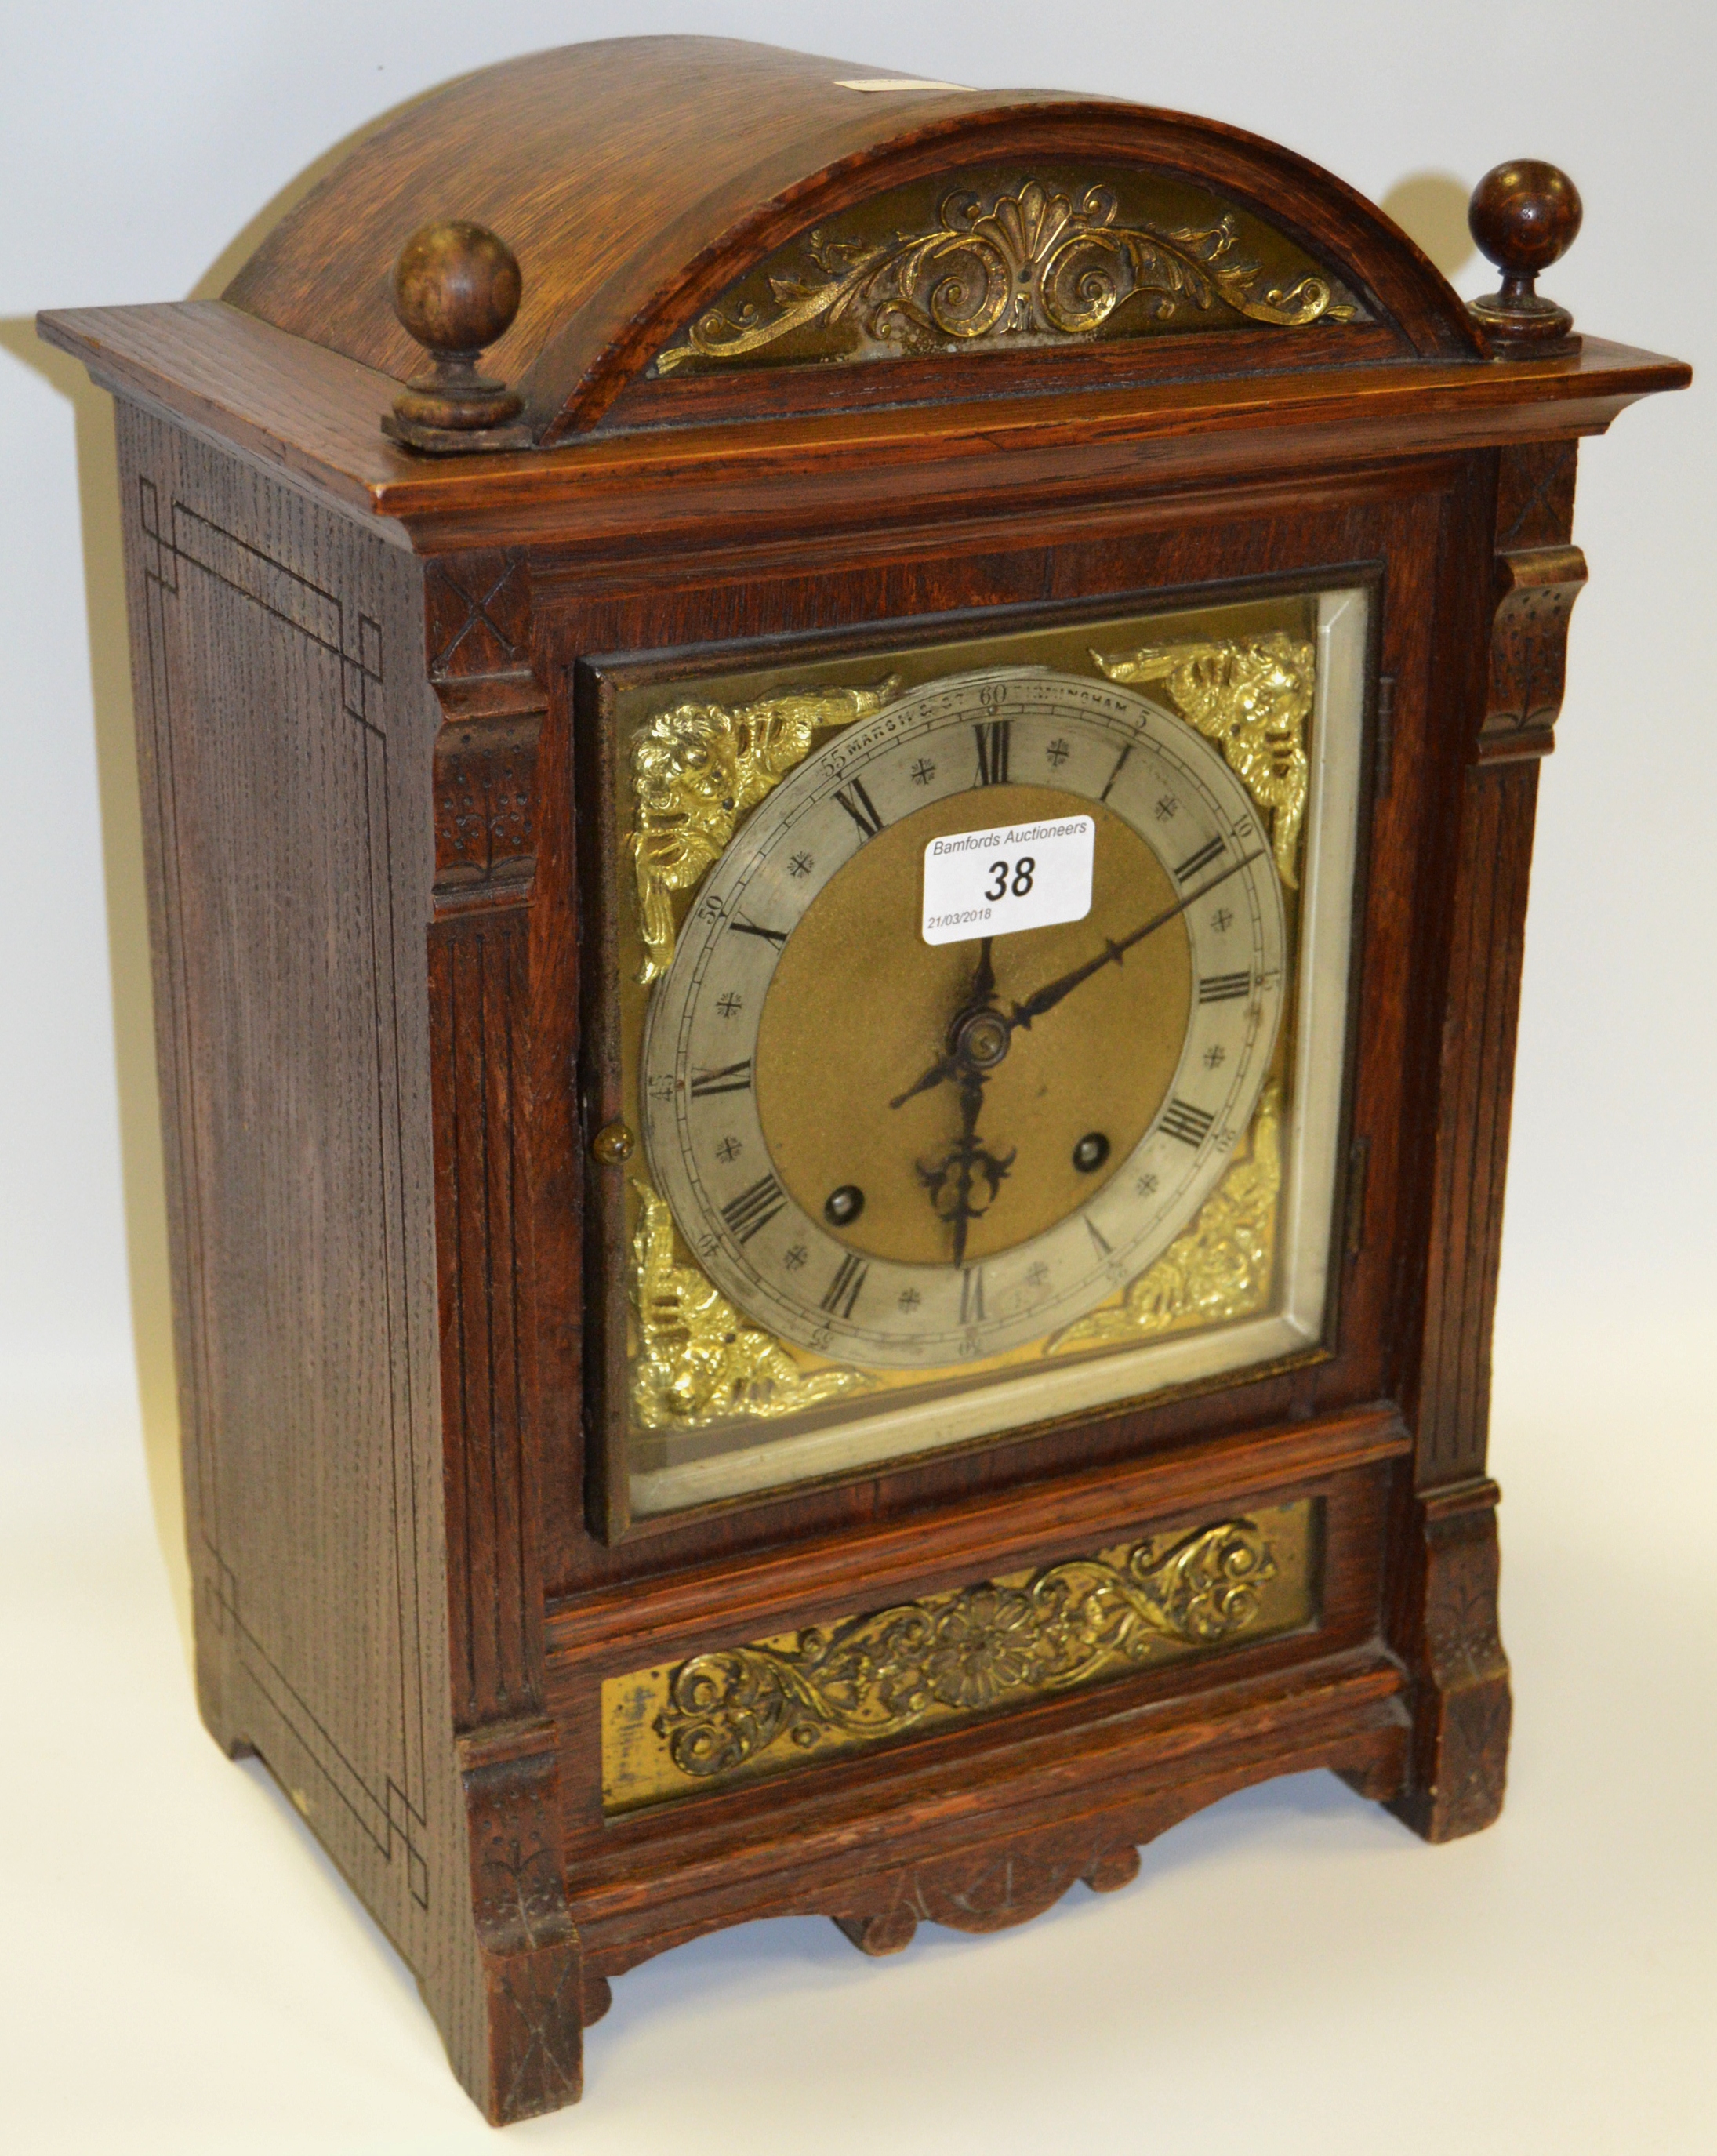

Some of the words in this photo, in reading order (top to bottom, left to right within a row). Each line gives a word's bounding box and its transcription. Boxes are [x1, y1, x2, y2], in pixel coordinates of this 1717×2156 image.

[980, 684, 1007, 706] 60
[1014, 684, 1127, 712] IRMINGHAM
[1137, 709, 1150, 730] 5
[820, 749, 847, 778] 55
[971, 719, 1016, 788] XII
[829, 774, 891, 845] XI
[1232, 813, 1254, 837] 10
[932, 833, 1001, 856] Bamfords
[1004, 821, 1087, 845] Auctioneers
[984, 856, 1036, 902] 38
[1173, 833, 1226, 886] II
[698, 895, 724, 924] 50
[725, 905, 792, 955] X
[927, 908, 993, 929] 21/03/2018
[1198, 967, 1251, 1005] III
[649, 1073, 674, 1102] 45
[690, 1057, 752, 1102] IX
[1157, 1098, 1216, 1148] IIII
[720, 1170, 788, 1245] VIII
[697, 1233, 720, 1258] 40
[1081, 1214, 1116, 1261] V
[820, 1252, 870, 1321] VII
[957, 1266, 987, 1325] VI
